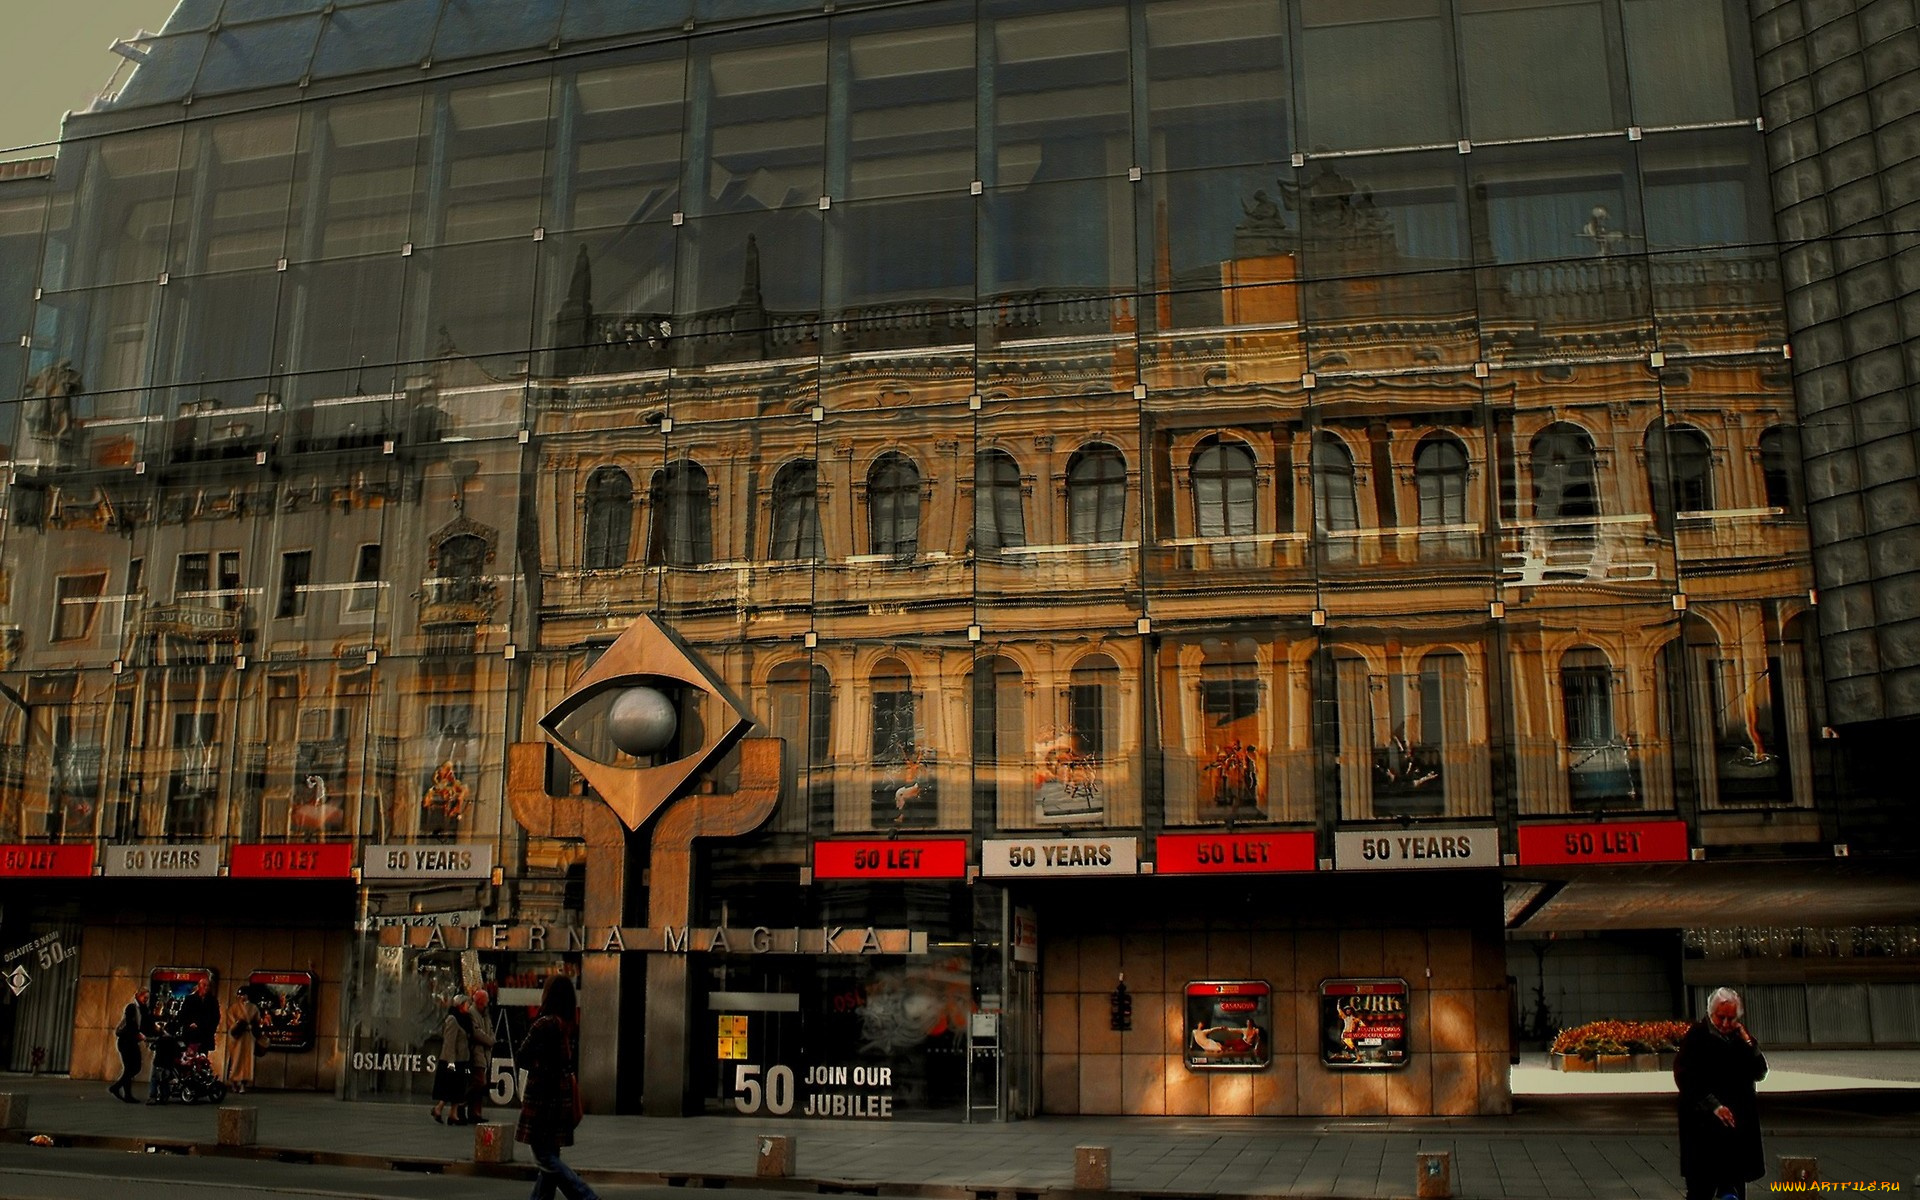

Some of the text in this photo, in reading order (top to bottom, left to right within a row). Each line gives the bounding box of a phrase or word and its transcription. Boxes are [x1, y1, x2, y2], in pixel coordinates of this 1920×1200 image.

[1197, 841, 1272, 865] 50 LET
[1362, 835, 1472, 860] 50 YEARS
[1564, 831, 1643, 855] 50 LET
[5, 851, 57, 869] 50 LET
[125, 850, 200, 869] 50 YEARS
[261, 850, 319, 870] 50 LET
[387, 850, 472, 870] 50 YEARS
[854, 848, 924, 870] 50 LET
[1009, 844, 1112, 867] 50 YEARS
[663, 926, 885, 953] MAGIKA
[37, 941, 64, 970] 50
[353, 1051, 437, 1072] OSLAVTE S
[804, 1066, 893, 1086] JOIN OUR
[734, 1063, 795, 1115] 50
[803, 1094, 893, 1117] JUBILEE
